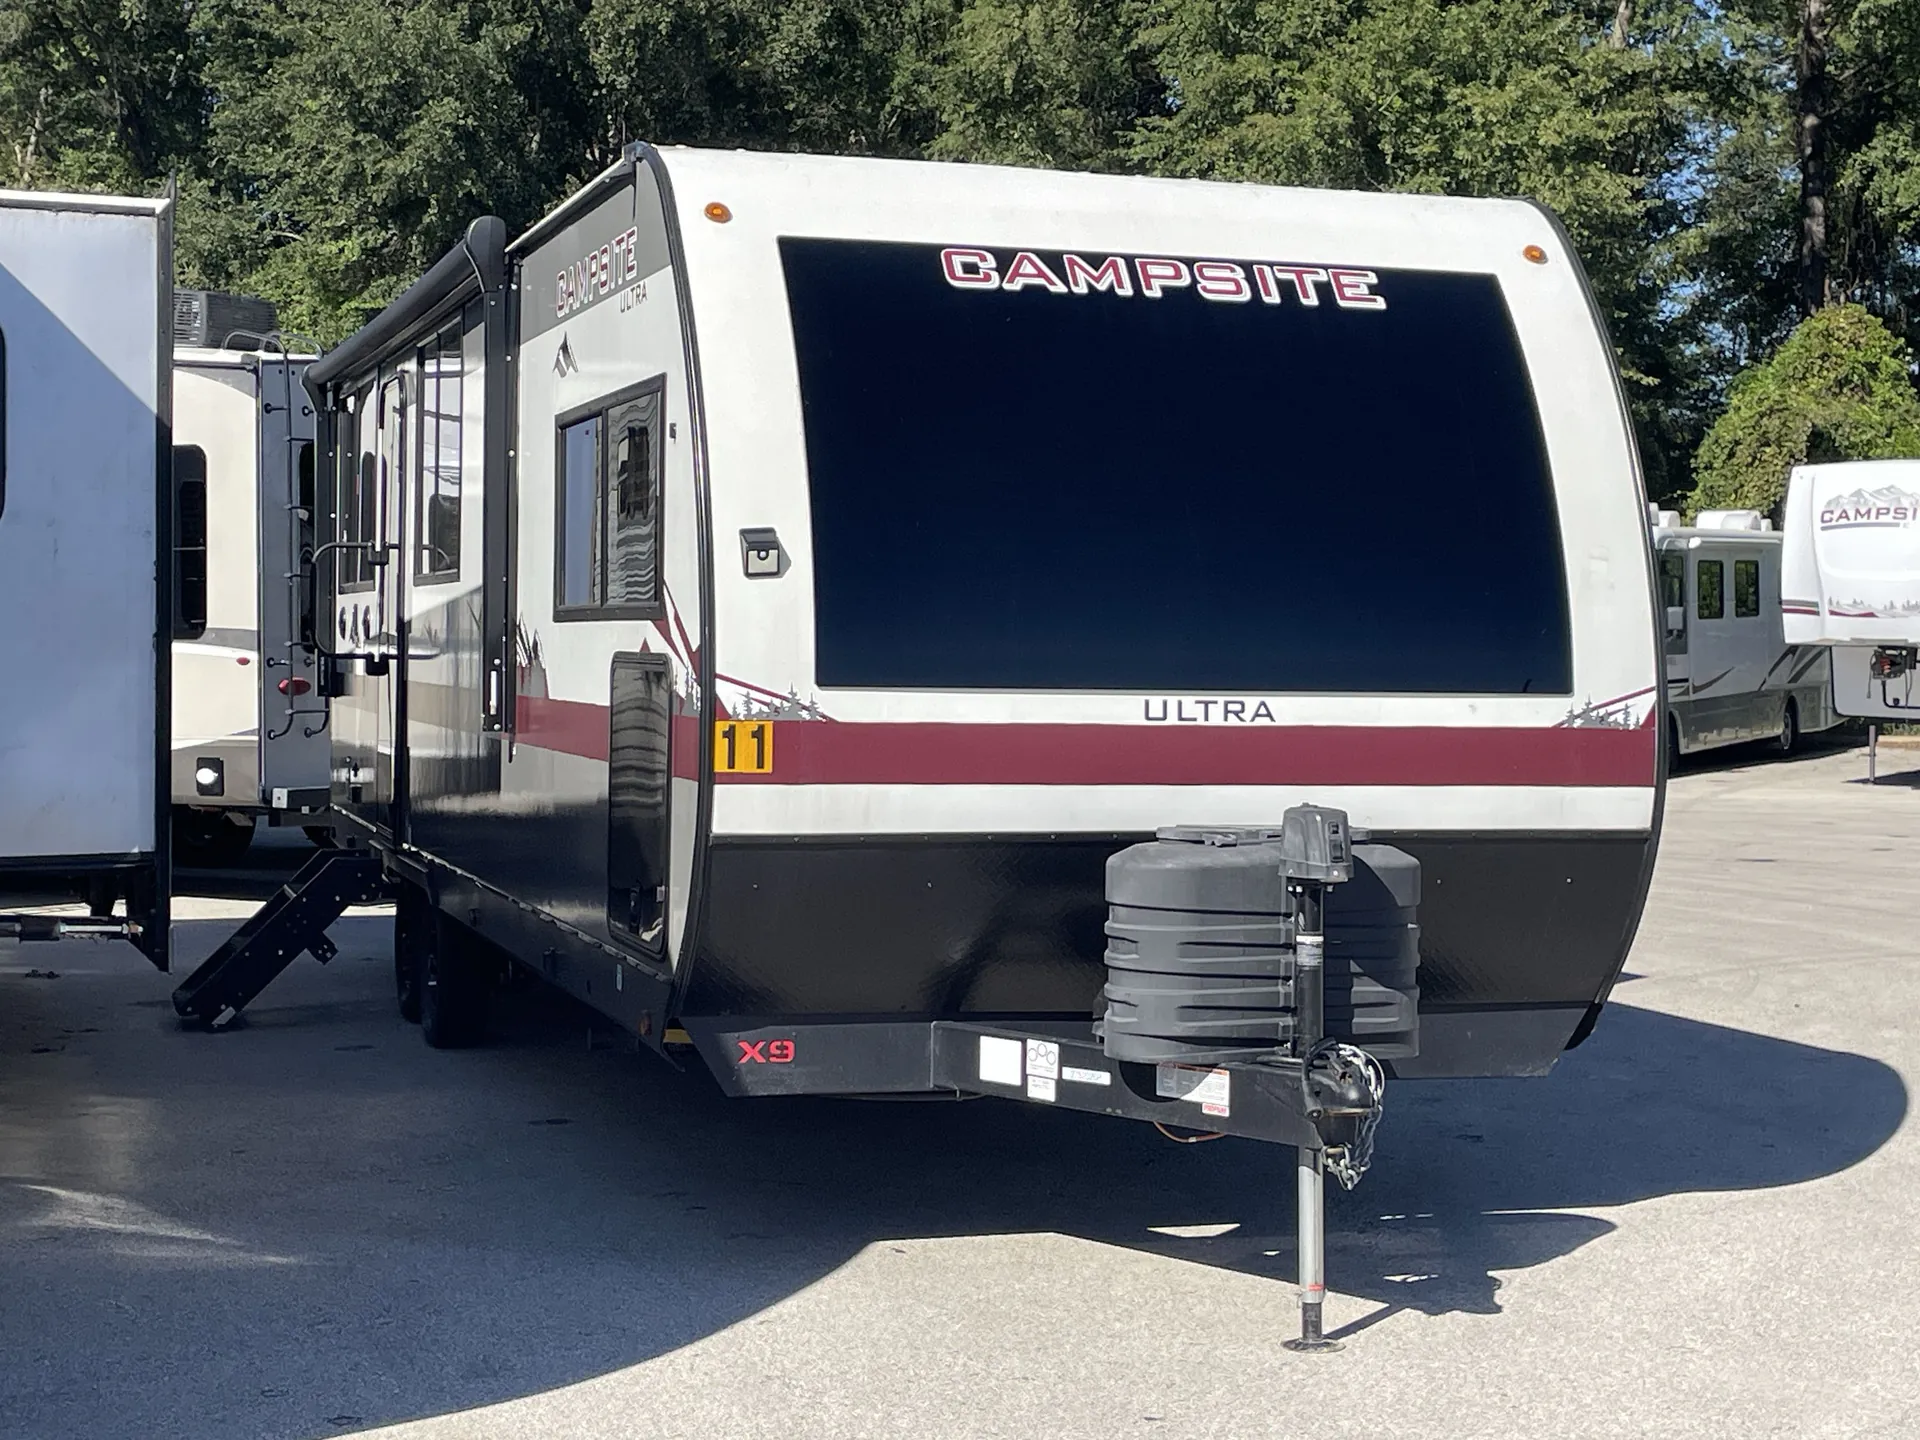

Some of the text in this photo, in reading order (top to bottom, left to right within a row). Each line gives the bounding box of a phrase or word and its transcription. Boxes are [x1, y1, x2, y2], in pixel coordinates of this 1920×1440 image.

[556, 226, 637, 318] CAMPSITE
[940, 248, 1387, 309] CAMPSITE
[620, 280, 648, 313] ULTRA
[1144, 699, 1276, 722] ULTRA
[722, 723, 765, 770] 11
[738, 1039, 795, 1064] X9
